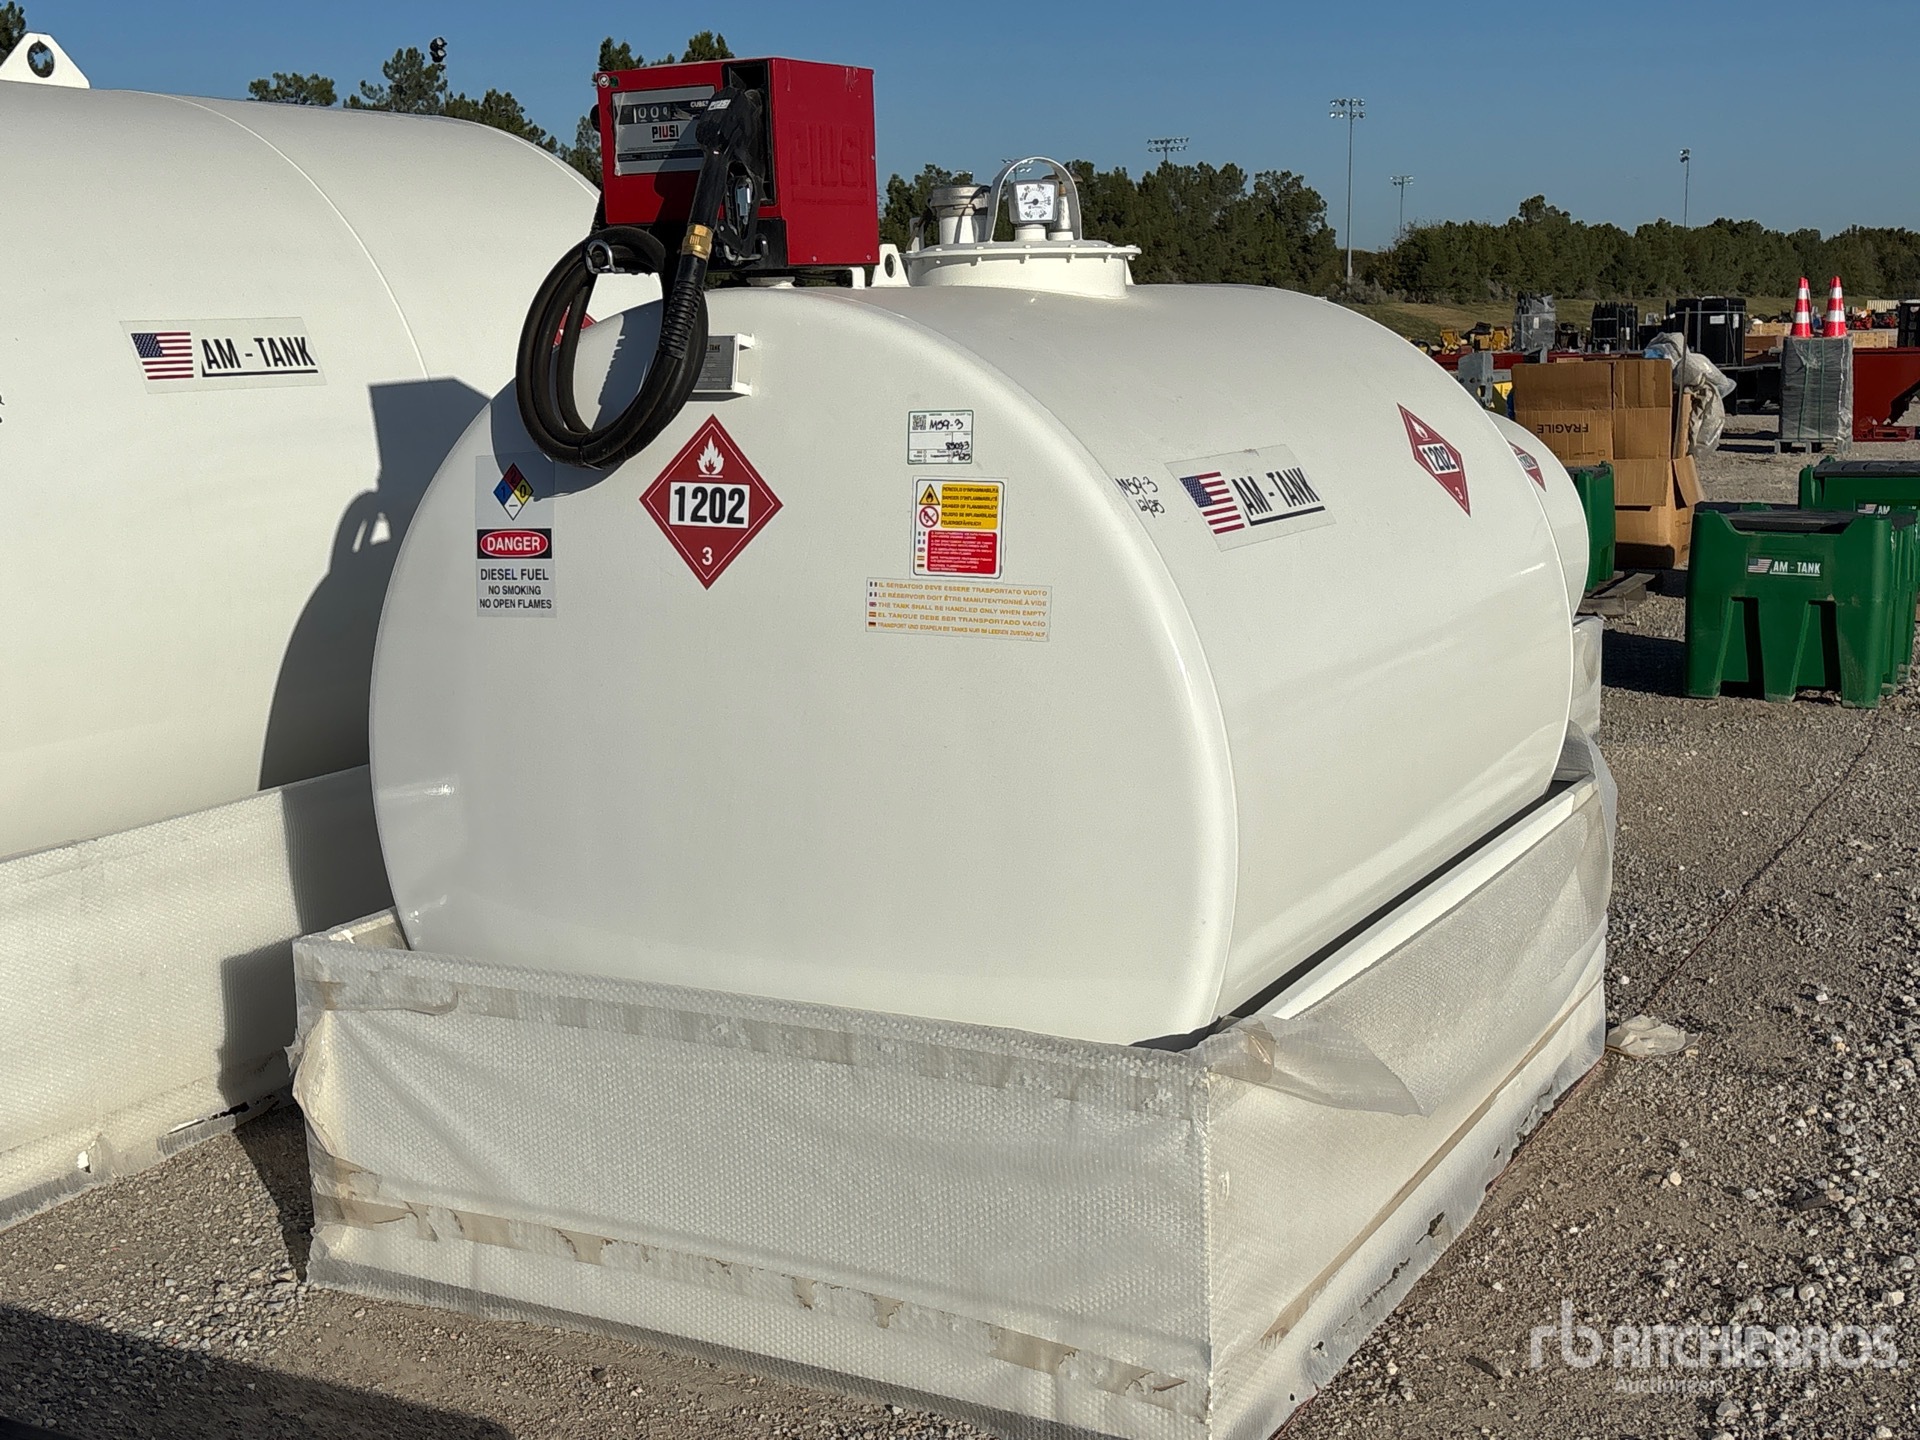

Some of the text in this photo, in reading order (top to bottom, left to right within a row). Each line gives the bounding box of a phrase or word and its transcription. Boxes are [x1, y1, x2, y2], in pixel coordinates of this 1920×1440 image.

[652, 125, 679, 139] PIUSI
[789, 121, 868, 187] PIUSI
[200, 337, 242, 370] AM
[253, 336, 316, 367] TANK
[1537, 423, 1589, 434] FRAGILE
[1422, 445, 1457, 471] 1202
[501, 485, 527, 498] 1 0
[1231, 476, 1272, 516] AM
[1267, 467, 1321, 508] TANK
[674, 485, 746, 525] 1202
[486, 536, 541, 552] DANGER
[701, 546, 713, 565] 3
[1772, 561, 1787, 573] AM
[1797, 561, 1821, 574] TANK
[480, 568, 549, 581] DIESEL FUEL
[488, 585, 541, 595] NO SMOKING
[886, 582, 923, 590] SERBATOIO
[972, 586, 1022, 595] TRASPORTATO
[888, 591, 925, 600] RÉSERVOIR
[944, 594, 961, 602] ÊTRE
[479, 598, 552, 609] NO OPEN FLAMES
[958, 616, 1021, 626] TRANSPORTADO
